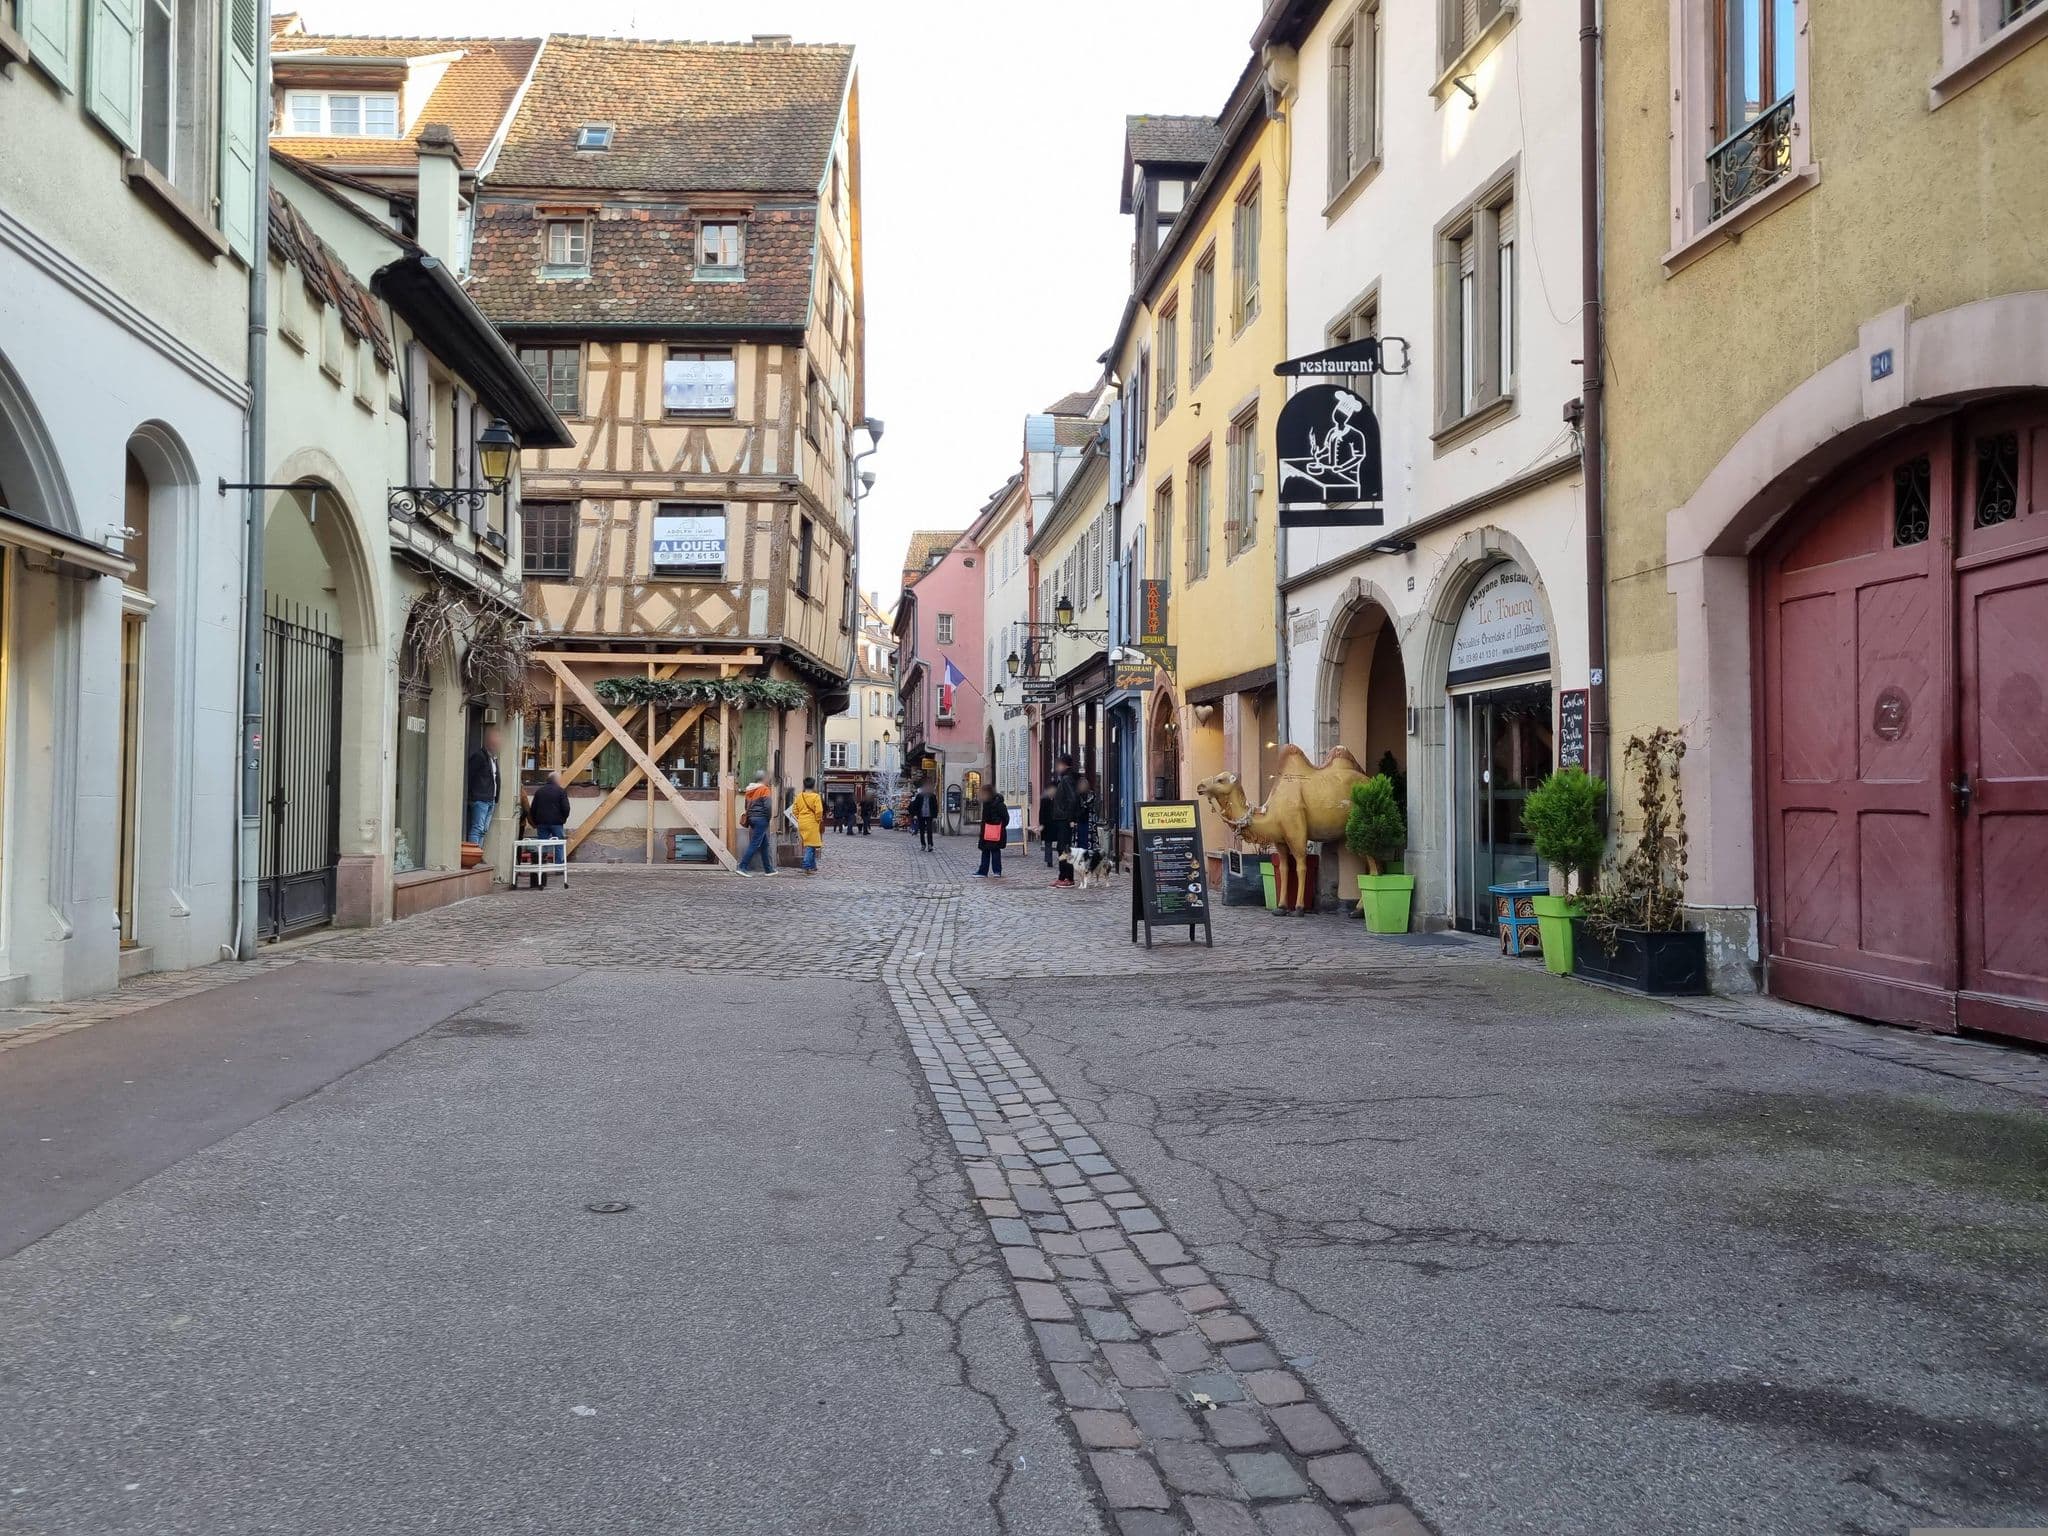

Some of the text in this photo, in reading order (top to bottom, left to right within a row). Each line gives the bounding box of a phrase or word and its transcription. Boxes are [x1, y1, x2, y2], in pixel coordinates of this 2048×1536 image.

[1300, 358, 1374, 373] restaurant
[658, 541, 720, 551] A LOUER
[1478, 602, 1492, 625] Le
